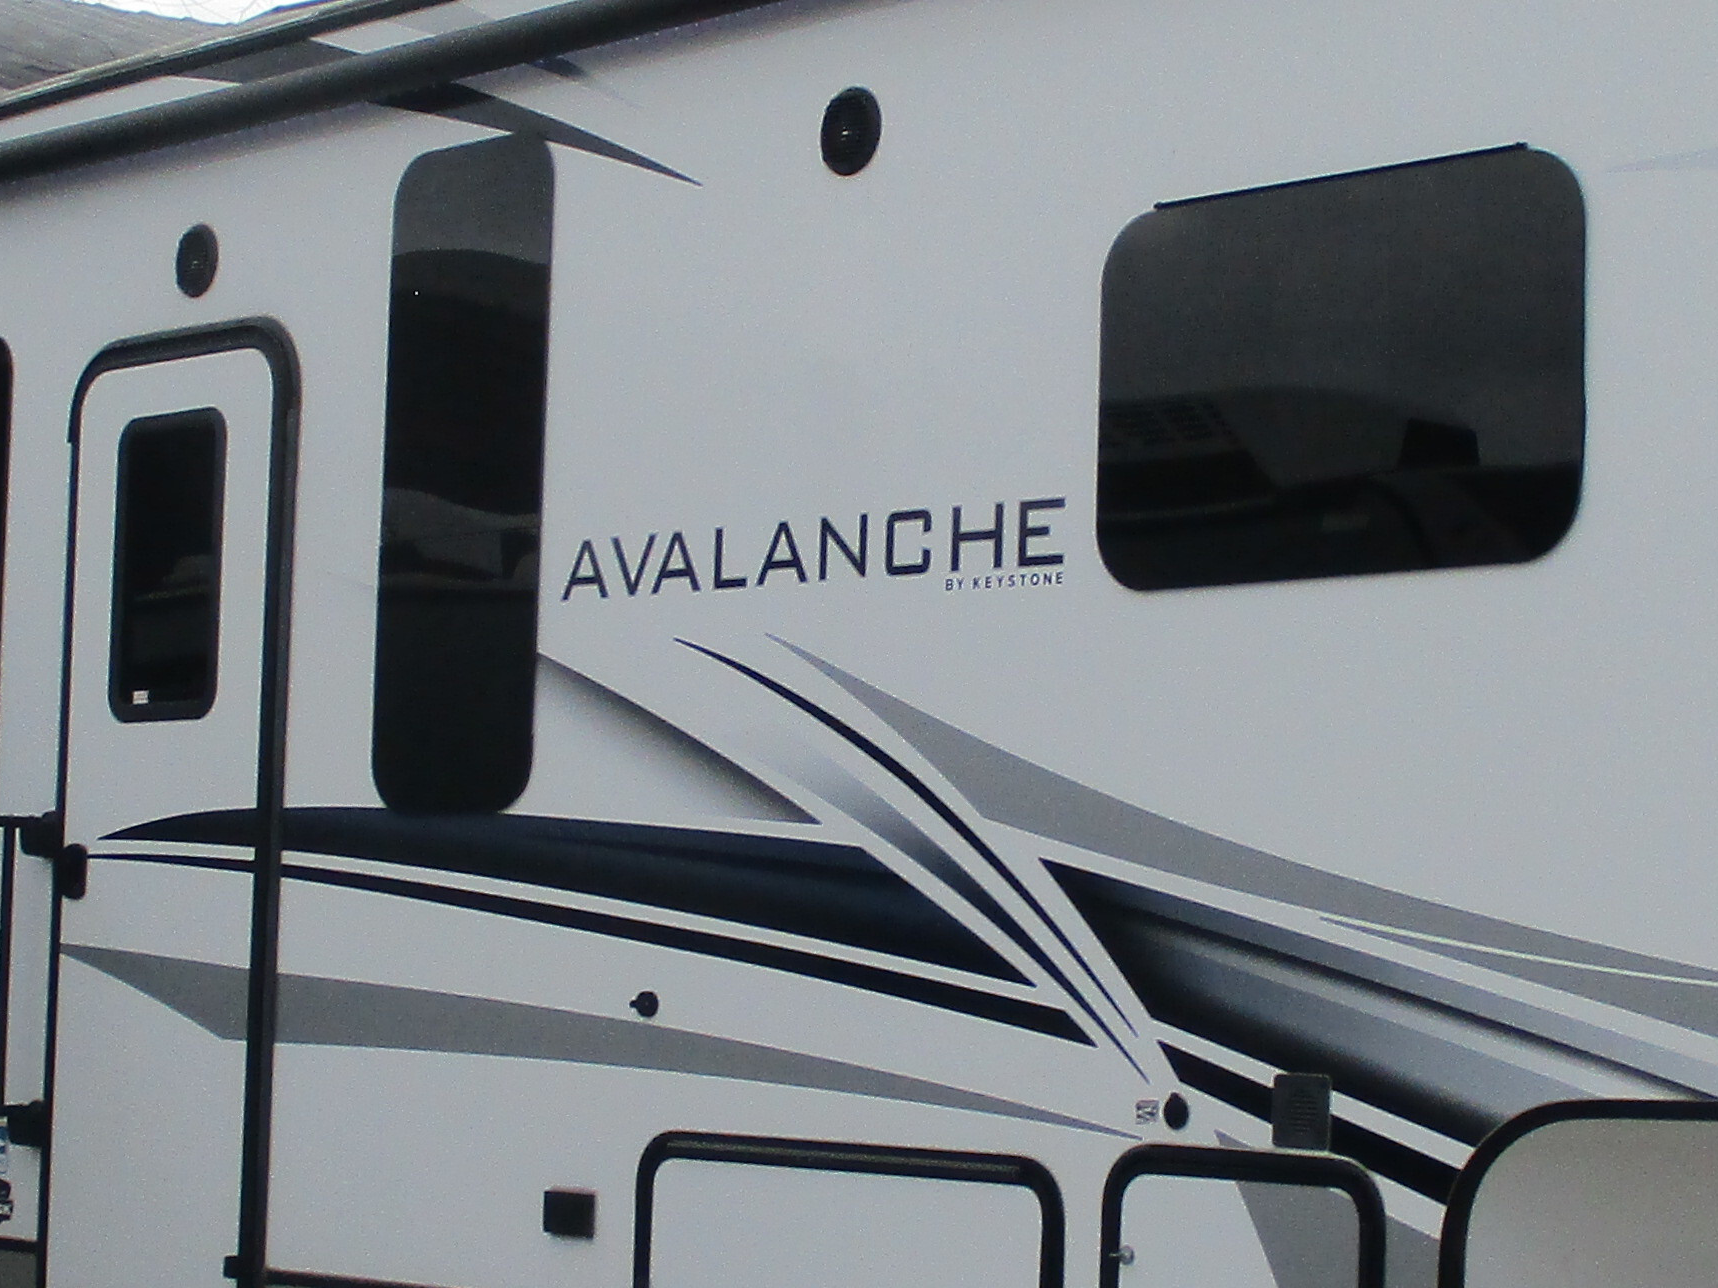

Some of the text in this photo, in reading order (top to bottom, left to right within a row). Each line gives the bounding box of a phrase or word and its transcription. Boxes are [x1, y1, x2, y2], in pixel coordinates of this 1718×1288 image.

[560, 496, 1067, 602] AVALANCHE
[944, 571, 1064, 591] BY KEYSTONE
